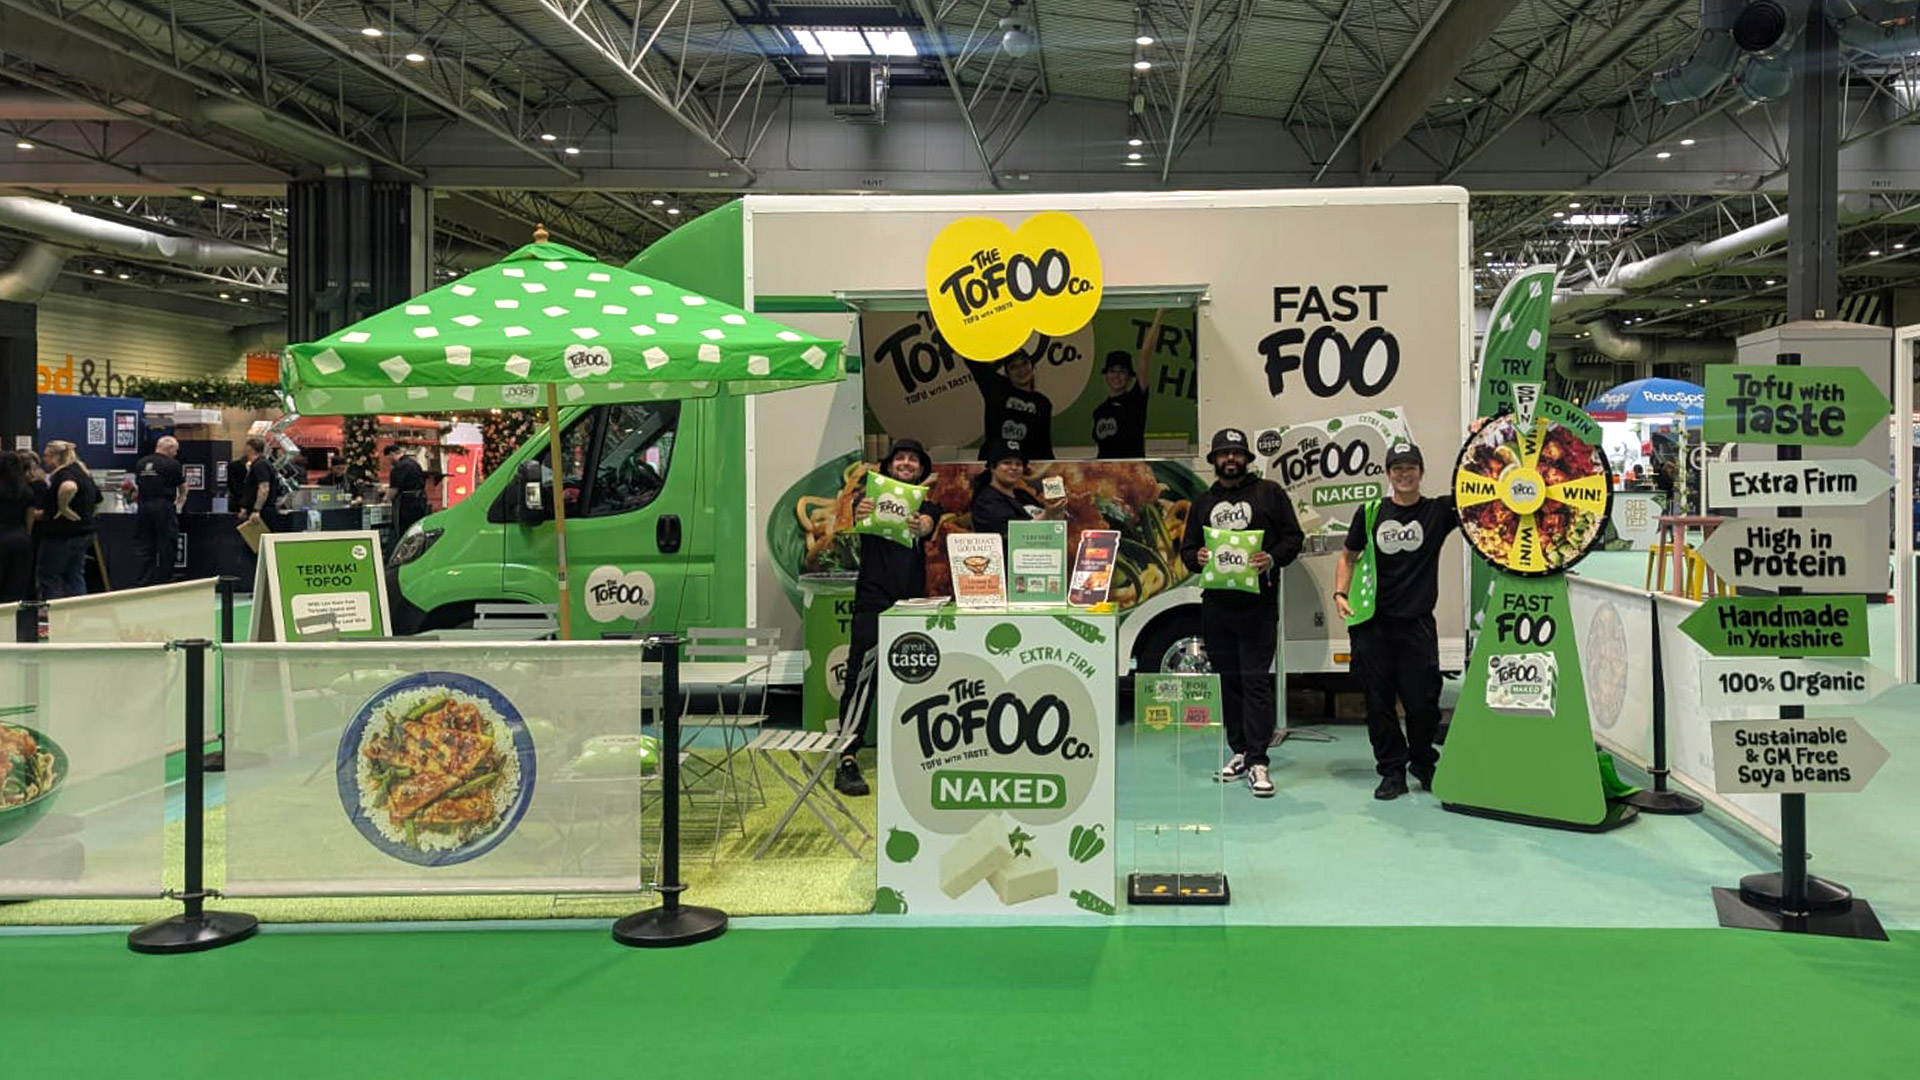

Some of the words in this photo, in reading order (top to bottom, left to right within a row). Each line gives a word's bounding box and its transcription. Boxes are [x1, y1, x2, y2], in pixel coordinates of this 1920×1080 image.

[971, 248, 1000, 269] THE
[1273, 285, 1388, 323] FAST
[1258, 325, 1400, 398] FOO
[1502, 359, 1532, 376] TRY
[79, 359, 100, 396] &
[1733, 373, 1793, 400] Tofu
[1800, 383, 1845, 401] with
[1517, 385, 1536, 424] SPIN
[1726, 398, 1845, 436] Taste
[1544, 402, 1562, 415] TO
[1565, 410, 1593, 435] WIN
[1298, 437, 1319, 453] THE
[1316, 485, 1378, 503] NAKED
[1461, 481, 1496, 496] WIN!
[1563, 487, 1602, 501] WIN!
[1729, 472, 1798, 497] Extra
[1804, 468, 1857, 494] Firm
[1519, 527, 1533, 566] WIN!
[1747, 527, 1800, 554] High
[1811, 528, 1832, 549] in
[297, 563, 357, 575] TERIYAKI
[1734, 548, 1846, 577] Protein
[304, 576, 352, 588] TOFOO
[1503, 593, 1554, 612] FAST
[1718, 604, 1849, 629] Handmade
[1495, 612, 1556, 647] FOO
[1728, 631, 1744, 646] in
[1747, 629, 1844, 648] Yorkshire
[891, 652, 938, 667] taste
[1020, 646, 1062, 665] EXTRA
[1065, 651, 1096, 679] FIRM
[948, 678, 986, 703] THE
[1719, 672, 1775, 694] 100%
[1780, 671, 1865, 696] Organic
[1735, 727, 1847, 747] Sustainable
[920, 758, 942, 772] TOFU
[963, 748, 989, 761] TASTE
[1746, 749, 1760, 763] &
[1763, 748, 1791, 765] GM
[1796, 748, 1838, 764] Free
[1738, 765, 1785, 788] Soya
[1791, 765, 1851, 783] beans
[939, 777, 1059, 804] NAKED
